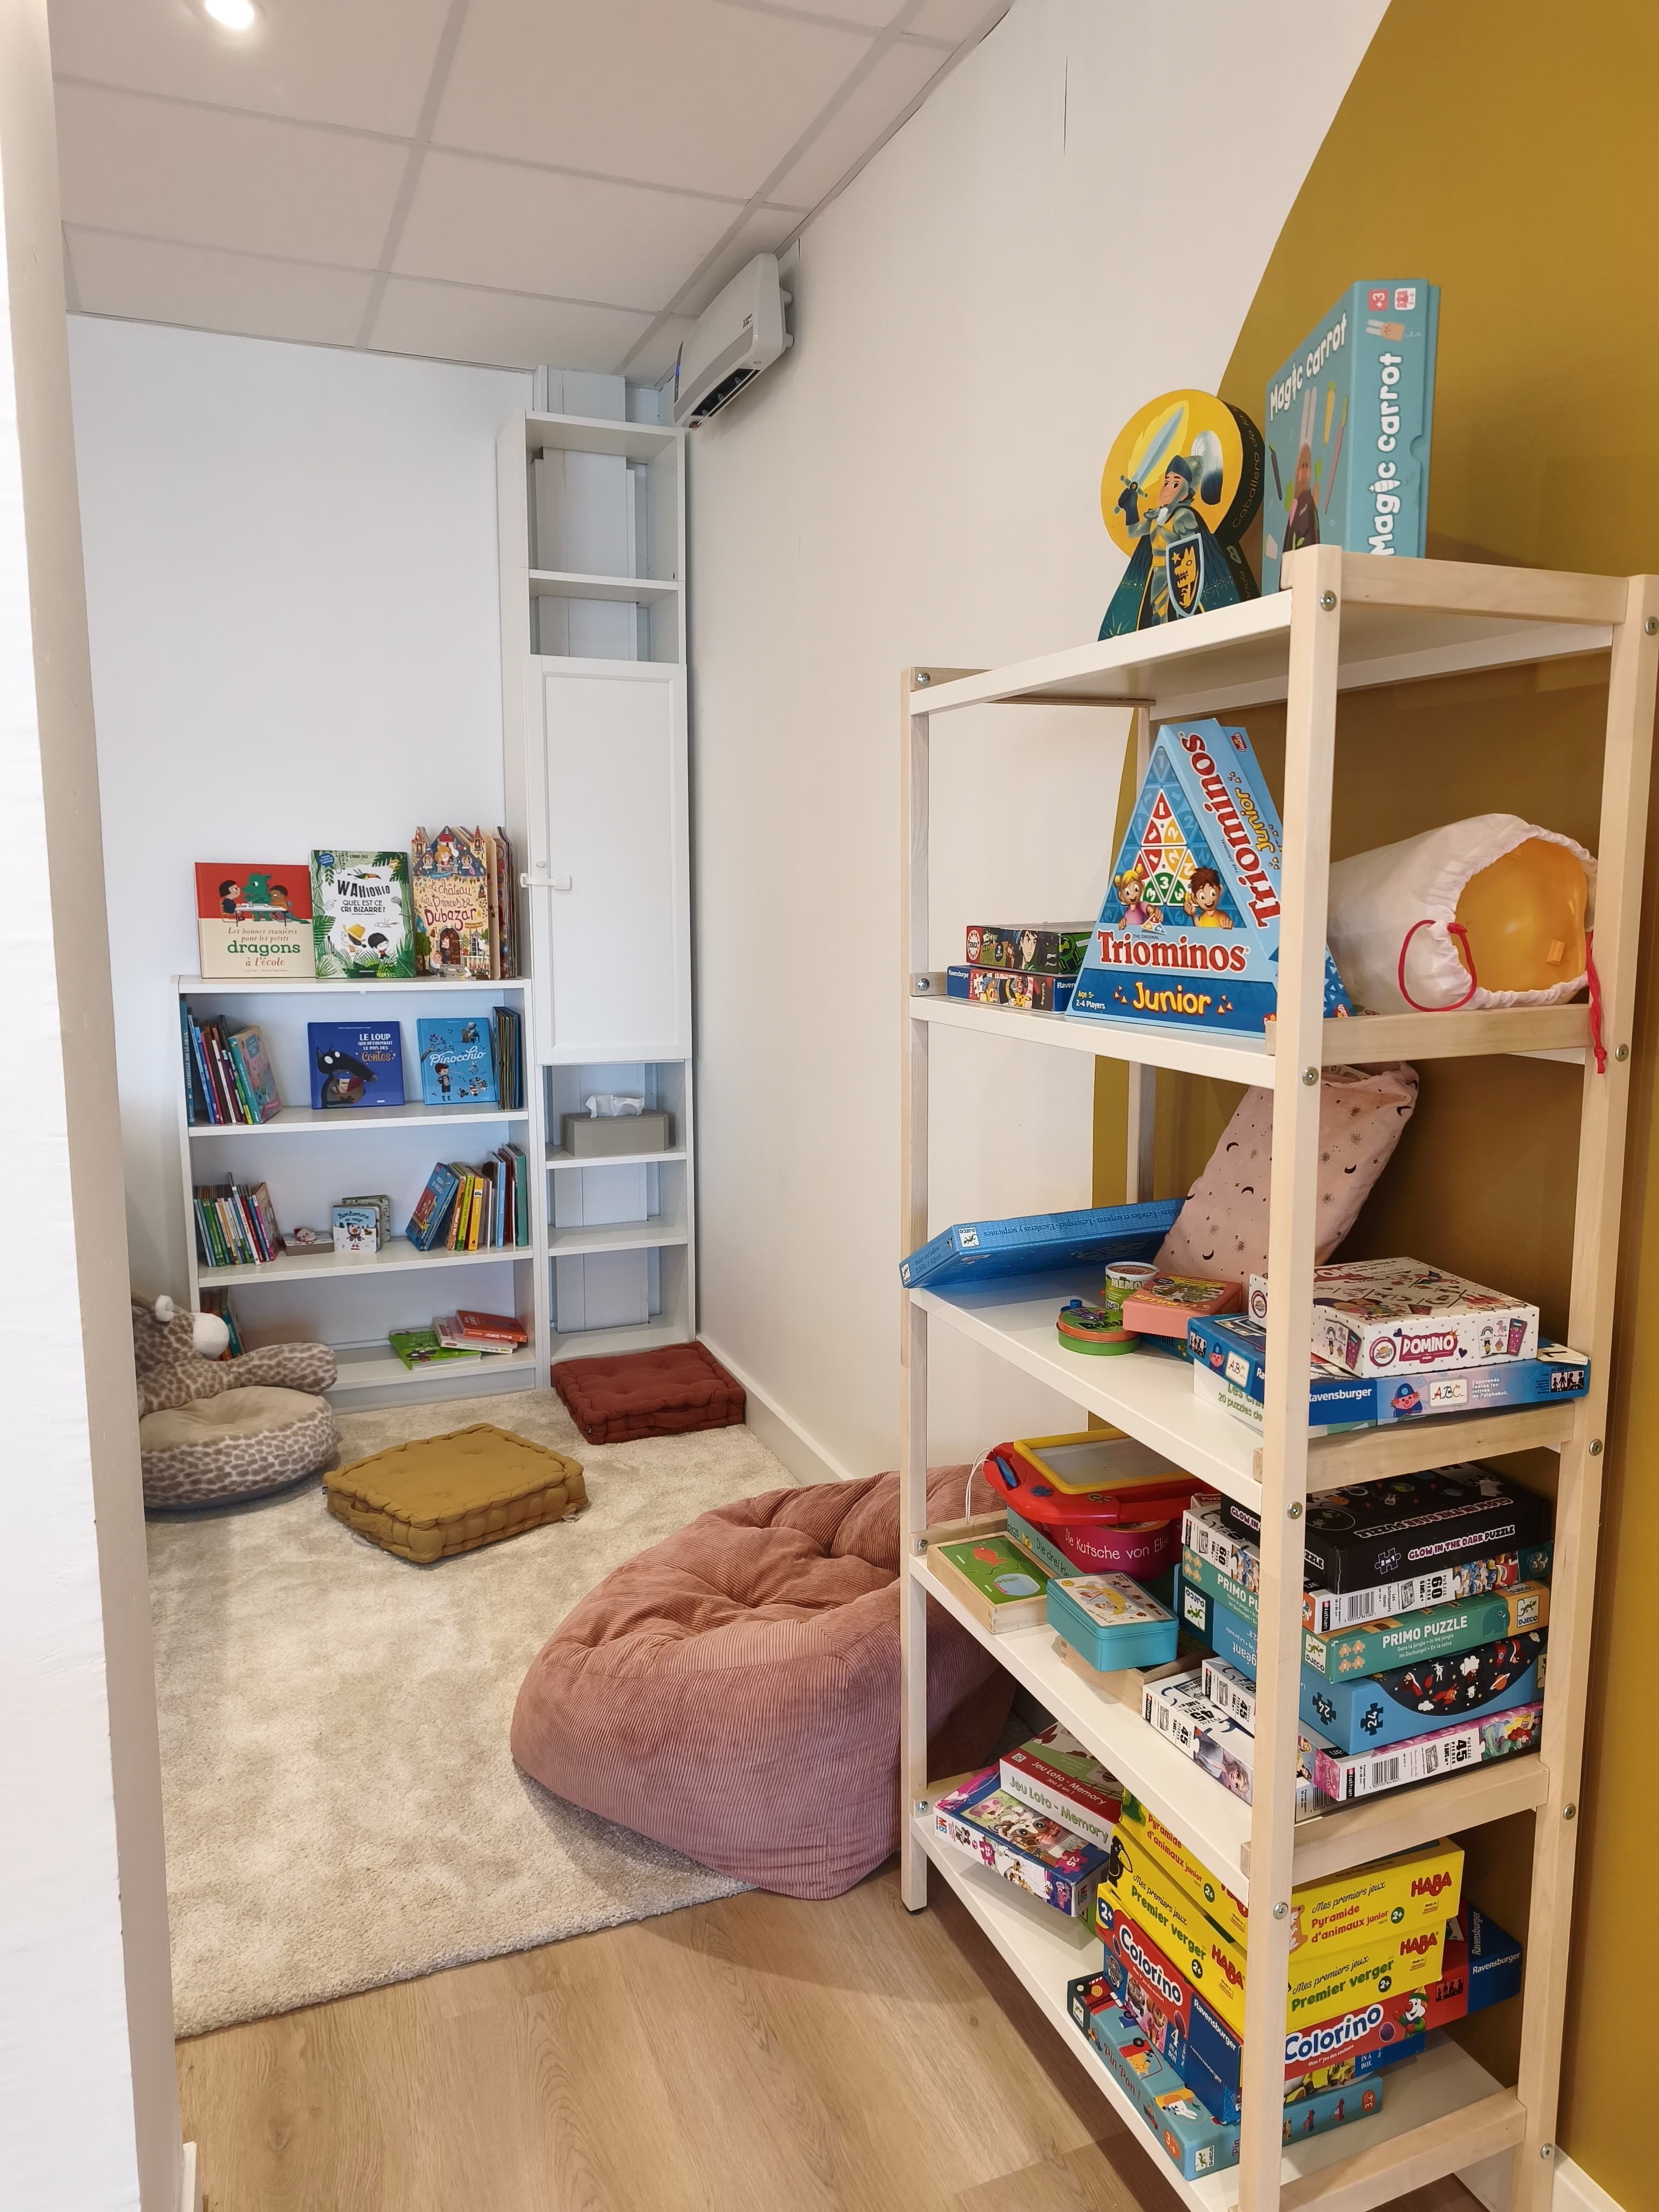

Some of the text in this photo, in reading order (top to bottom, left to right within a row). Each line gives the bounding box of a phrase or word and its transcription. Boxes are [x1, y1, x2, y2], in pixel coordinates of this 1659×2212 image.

[1270, 312, 1347, 422] Magic carrot
[1368, 353, 1402, 555] Magic carrot
[1232, 452, 1259, 528] Caballero
[1248, 430, 1257, 448] de
[1182, 733, 1280, 928] Triominos
[1235, 788, 1276, 854] Junior
[439, 879, 472, 896] château
[424, 908, 476, 931] Dubazar
[227, 940, 300, 956] dragons
[1097, 930, 1247, 972] Triominos
[246, 957, 251, 966] à
[1087, 1001, 1105, 1010] Players
[1132, 981, 1211, 1015] Junior
[361, 1051, 391, 1062] Contes
[430, 1046, 486, 1066] Pinocchio
[338, 1211, 369, 1219] Bonhomme
[1403, 1335, 1454, 1354] DOMINO
[1218, 1393, 1226, 1403] 20
[1227, 1398, 1252, 1417] puzzles
[1253, 1409, 1263, 1421] de
[1231, 1506, 1259, 1531] GLOW IN
[1065, 1527, 1074, 1546] Die
[1076, 1539, 1121, 1560] Kutsche
[1126, 1546, 1150, 1559] von
[1407, 1525, 1515, 1561] GLOW IN THE DARK PUZZLE
[1219, 1546, 1226, 1566] 60
[1185, 1589, 1205, 1608] DJECO
[1218, 1573, 1246, 1602] PRIMO
[1432, 1576, 1442, 1599] 60
[1382, 1616, 1467, 1648] PRIMO PUZZLE
[1519, 1615, 1538, 1626] DJECO
[1405, 1647, 1427, 1657] Dschungel
[1413, 1640, 1426, 1650] jungle
[1441, 1634, 1454, 1642] jungle
[1232, 1642, 1257, 1666] géant
[1306, 1655, 1325, 1672] DJECO
[1190, 1710, 1215, 1721] 45
[1240, 1701, 1248, 1721] 45
[1319, 1702, 1329, 1717] 24
[1367, 1711, 1377, 1727] 24
[1180, 1726, 1189, 1746] 45
[1456, 1739, 1467, 1762] 45
[1031, 1762, 1047, 1772] Jeu
[1048, 1769, 1064, 1782] Loto
[1070, 1782, 1106, 1805] Memory
[1010, 1776, 1109, 1844] Jeu Loto Memory
[939, 1817, 947, 1834] MB
[984, 1845, 991, 1857] 25
[1066, 1856, 1080, 1867] 25
[1147, 1831, 1203, 1882] d'animaux junior
[1410, 1871, 1452, 1898] HABA
[1133, 1875, 1188, 1925] Mes premiers jeux
[1312, 1881, 1386, 1913] Mes premiers jeux
[1100, 1902, 1113, 1920] 2+
[1311, 1905, 1360, 1928] Pyramide
[1393, 1910, 1403, 1920] 2+
[1131, 1885, 1206, 1961] Premier verger
[1311, 1910, 1389, 1944] d'animaux junior
[1472, 1911, 1482, 1955] Ravensburger
[1400, 1932, 1438, 1956] HABA
[1121, 1926, 1182, 2004] Colorino
[1211, 1944, 1244, 1990] HABA
[1292, 1955, 1369, 1994] Mes premiers jeux
[1473, 1953, 1520, 1974] Ravensburger
[1291, 1960, 1394, 2012] Premier verger
[1380, 1979, 1390, 1990] 2+
[1194, 1998, 1236, 2051] Ravensburger
[1285, 2007, 1381, 2058] Colorino
[1171, 2028, 1178, 2047] 4
[1168, 2049, 1177, 2064] BOX
[1361, 2060, 1372, 2069] BOX
[1103, 2043, 1118, 2071] Pin
[1119, 2065, 1136, 2097] Pon
[1232, 2139, 1240, 2156] Pin
